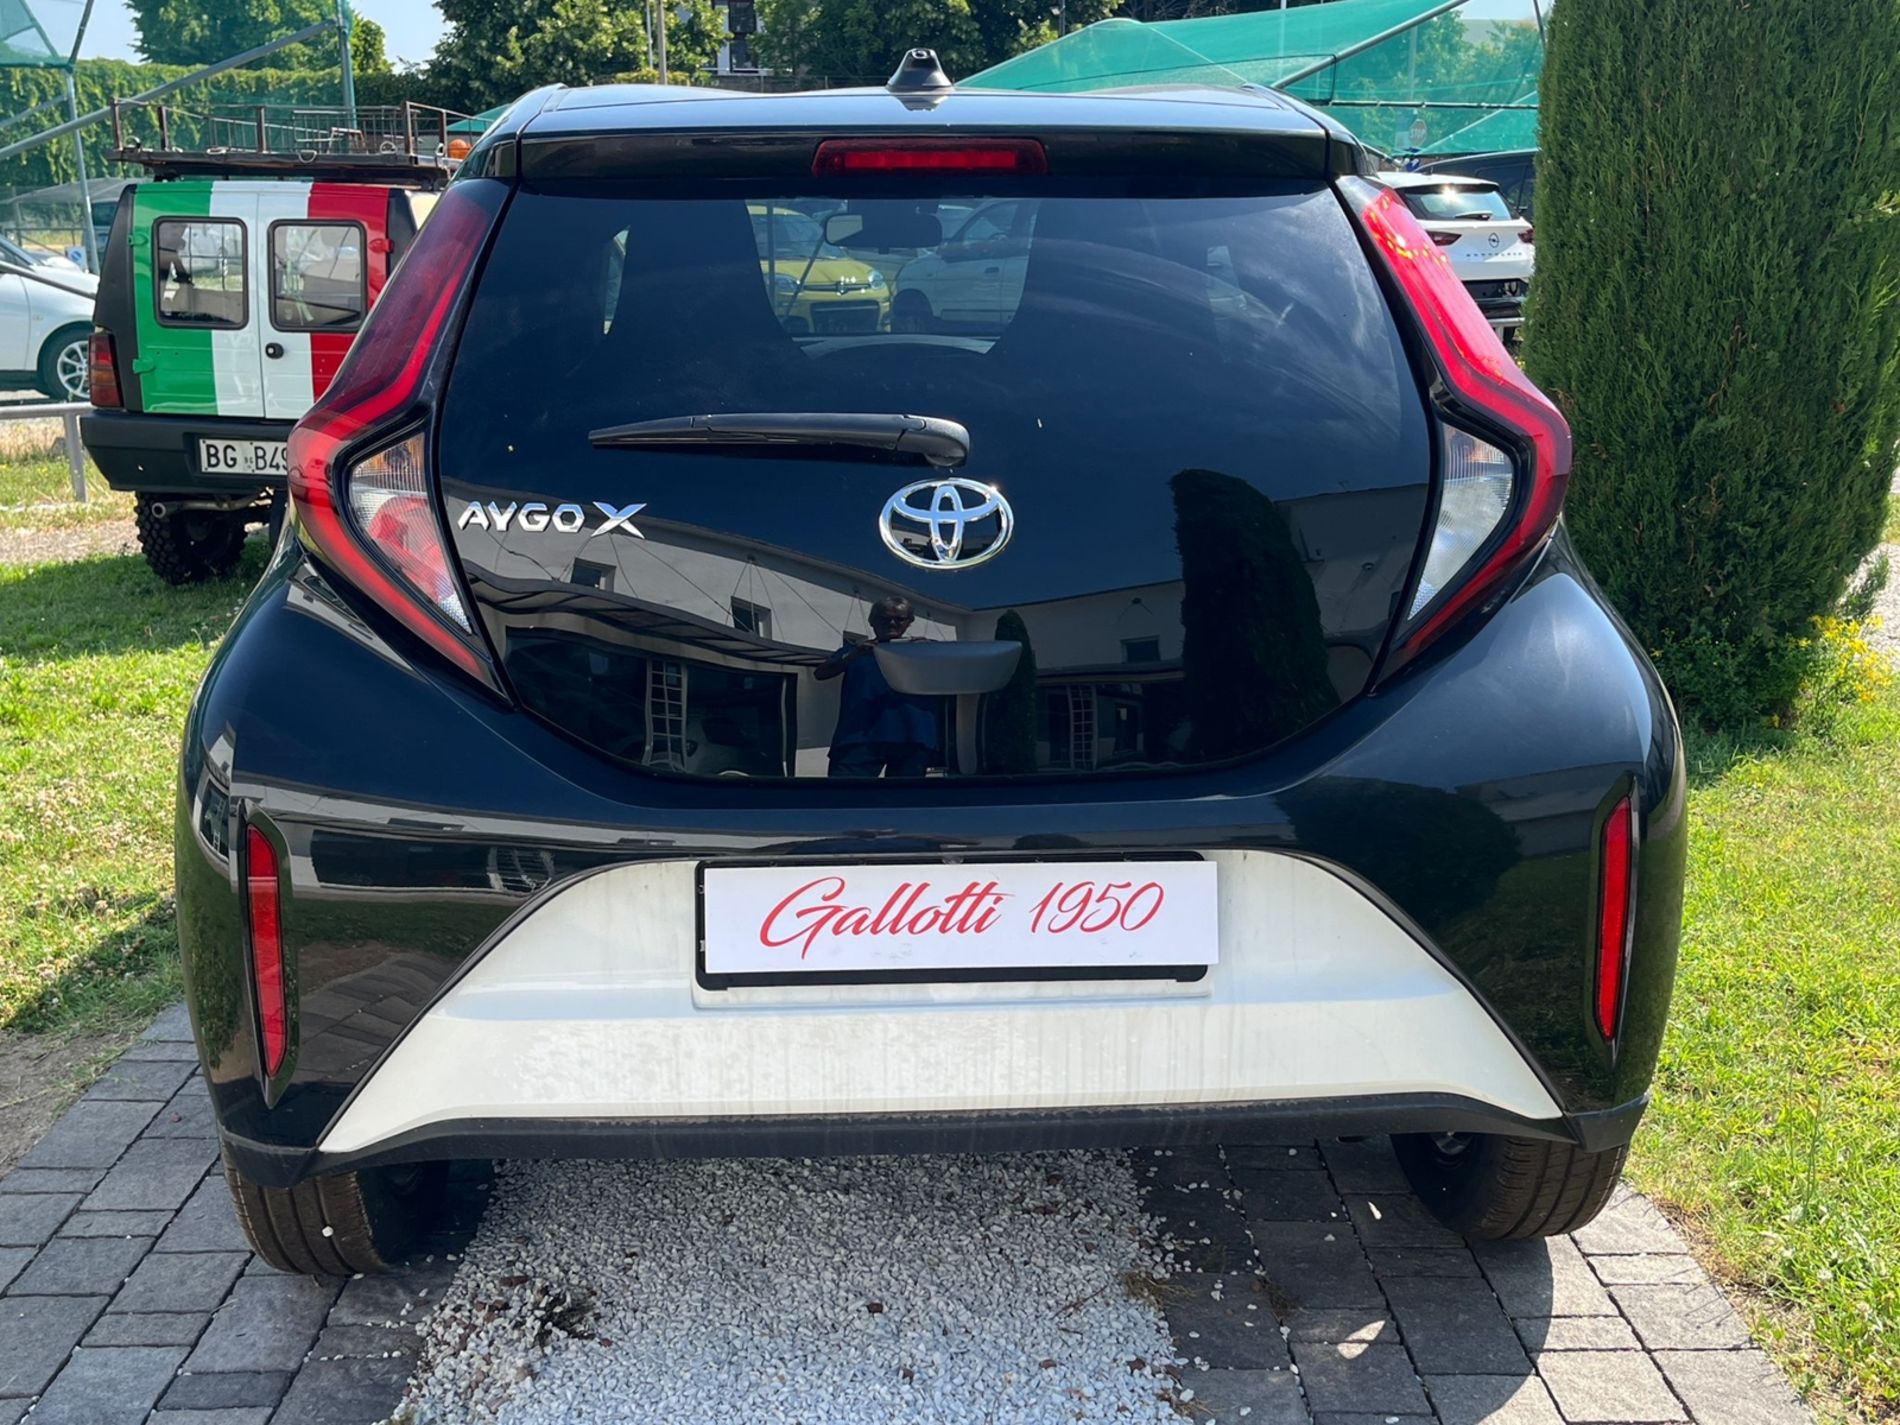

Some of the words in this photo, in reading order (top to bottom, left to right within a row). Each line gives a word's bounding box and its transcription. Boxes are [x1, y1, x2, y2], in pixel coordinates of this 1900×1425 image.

[206, 444, 238, 468] BG
[457, 501, 585, 533] AYGO
[590, 501, 648, 539] X
[759, 876, 1015, 960] Gallotti
[1029, 881, 1165, 934] 1950
